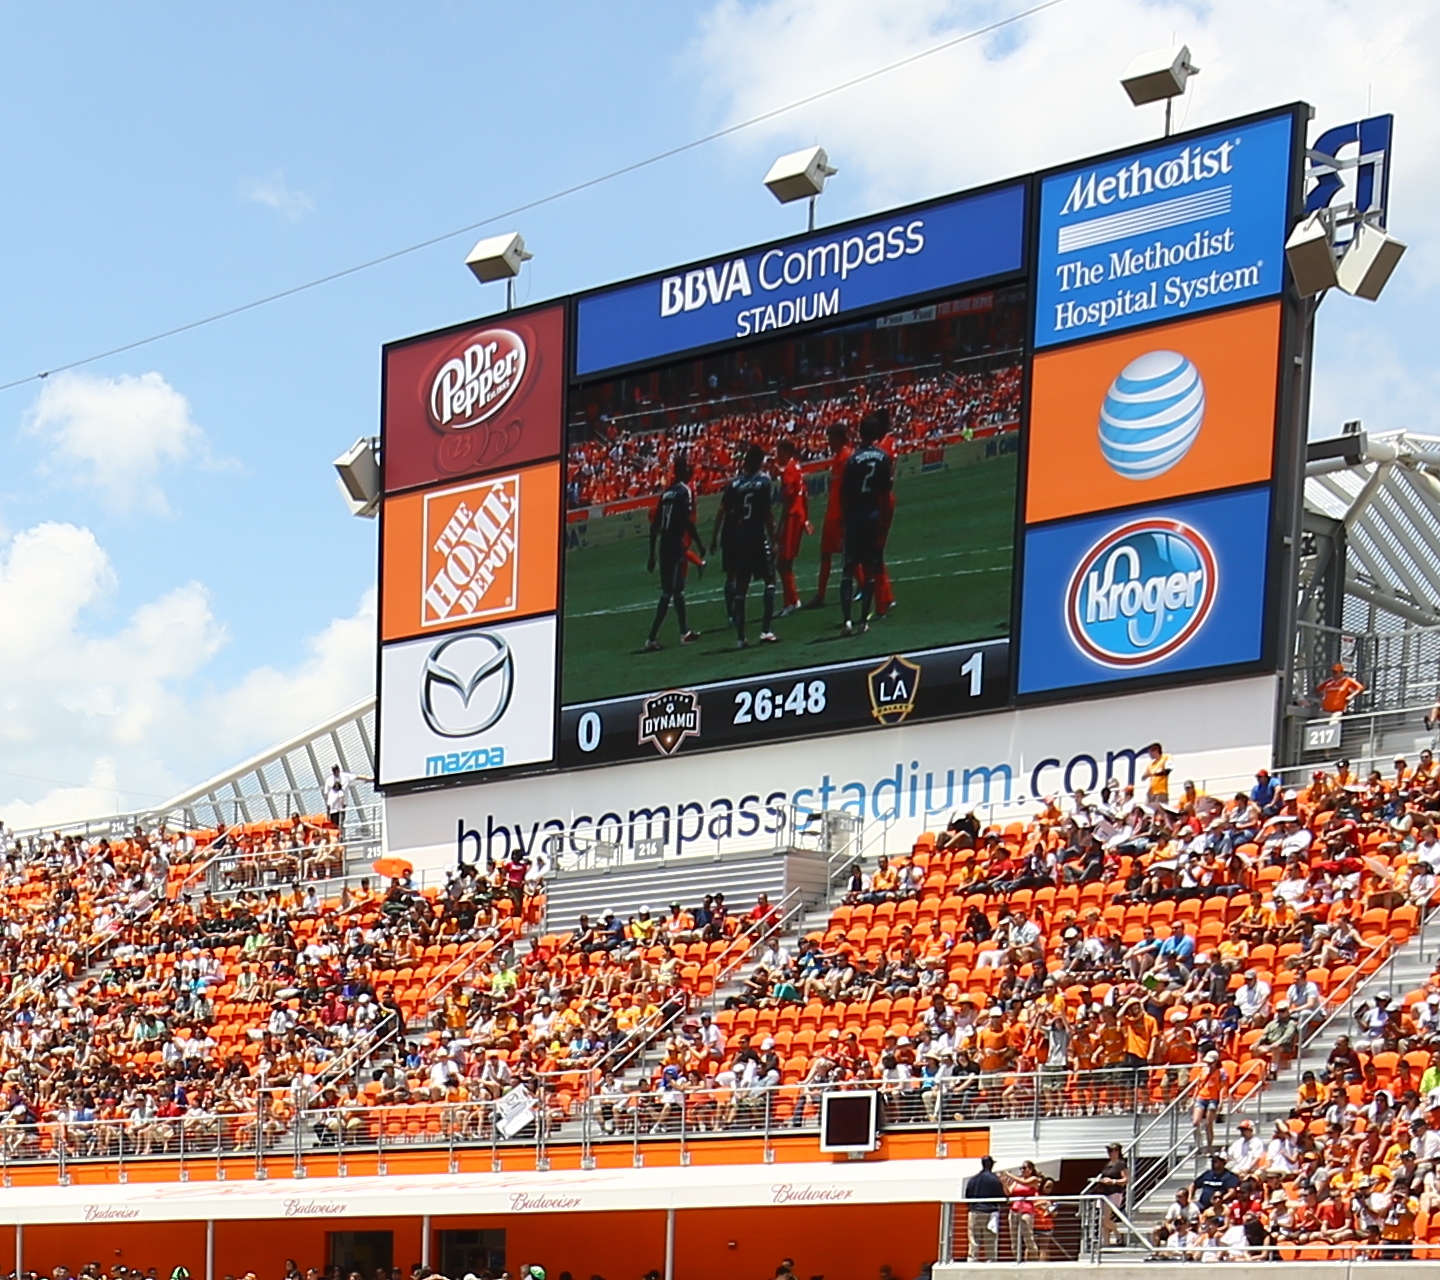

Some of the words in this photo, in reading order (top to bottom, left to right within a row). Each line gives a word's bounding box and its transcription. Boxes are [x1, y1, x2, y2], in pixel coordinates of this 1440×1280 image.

[1058, 140, 1234, 216] Methodist
[661, 257, 752, 318] BBVA
[758, 221, 924, 290] Compass
[1056, 262, 1104, 292] The
[1108, 227, 1235, 282] Methodist
[736, 288, 840, 338] STADIUM
[1054, 284, 1158, 331] Hospital
[1164, 264, 1260, 308] System
[464, 341, 498, 377] Dr
[425, 482, 518, 620] HOME
[433, 501, 474, 558] THE
[457, 527, 517, 615] DEPOT
[1086, 544, 1202, 647] Kroger
[879, 679, 908, 703] LA
[960, 651, 985, 697] 1
[645, 714, 695, 734] DYNAMO
[733, 681, 827, 725] 26:48
[577, 712, 602, 753] 0
[1310, 731, 1334, 745] 217
[455, 743, 1156, 865] bbvacompassstadium.com
[639, 842, 657, 857] 216
[84, 1205, 140, 1222] Budweiser
[284, 1199, 346, 1217] Budweiser
[509, 1193, 582, 1211] Budweiser
[772, 1184, 854, 1203] Budweiser
